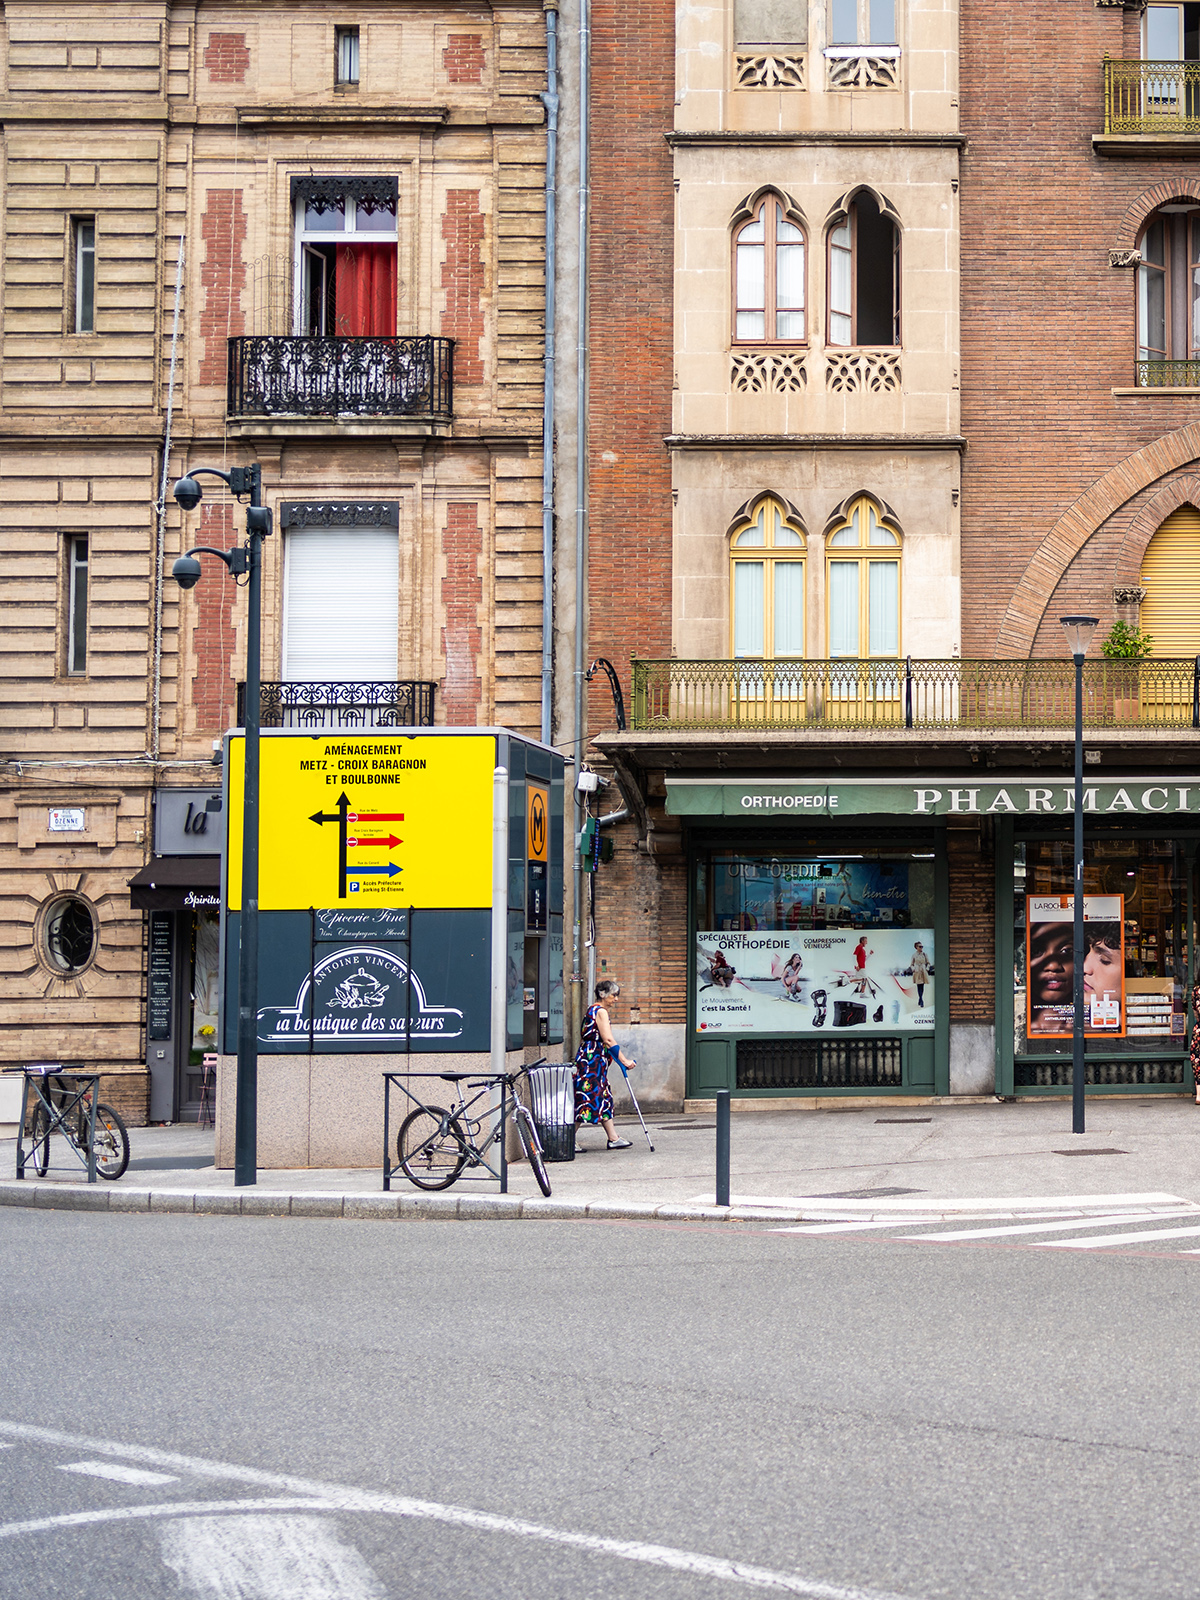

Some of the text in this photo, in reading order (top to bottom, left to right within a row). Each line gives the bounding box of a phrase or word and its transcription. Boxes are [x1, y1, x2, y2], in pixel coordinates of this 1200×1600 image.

[324, 742, 403, 756] AMÉNAGEMENT
[299, 760, 328, 771] METZ
[337, 759, 369, 770] CROIX
[371, 758, 427, 770] BARAGNON
[325, 773, 401, 785] ET BOULBONNE
[741, 795, 839, 808] ORTHOPEDIE
[184, 801, 208, 835] la
[728, 856, 821, 879] ORTOPEDIE
[371, 908, 406, 923] Fine
[699, 933, 748, 942] SPÉCIALISTE
[719, 938, 790, 950] ORTHOPÉDIE
[314, 956, 360, 986] ANTOINE
[294, 1013, 357, 1035] boutique
[361, 1013, 385, 1031] des
